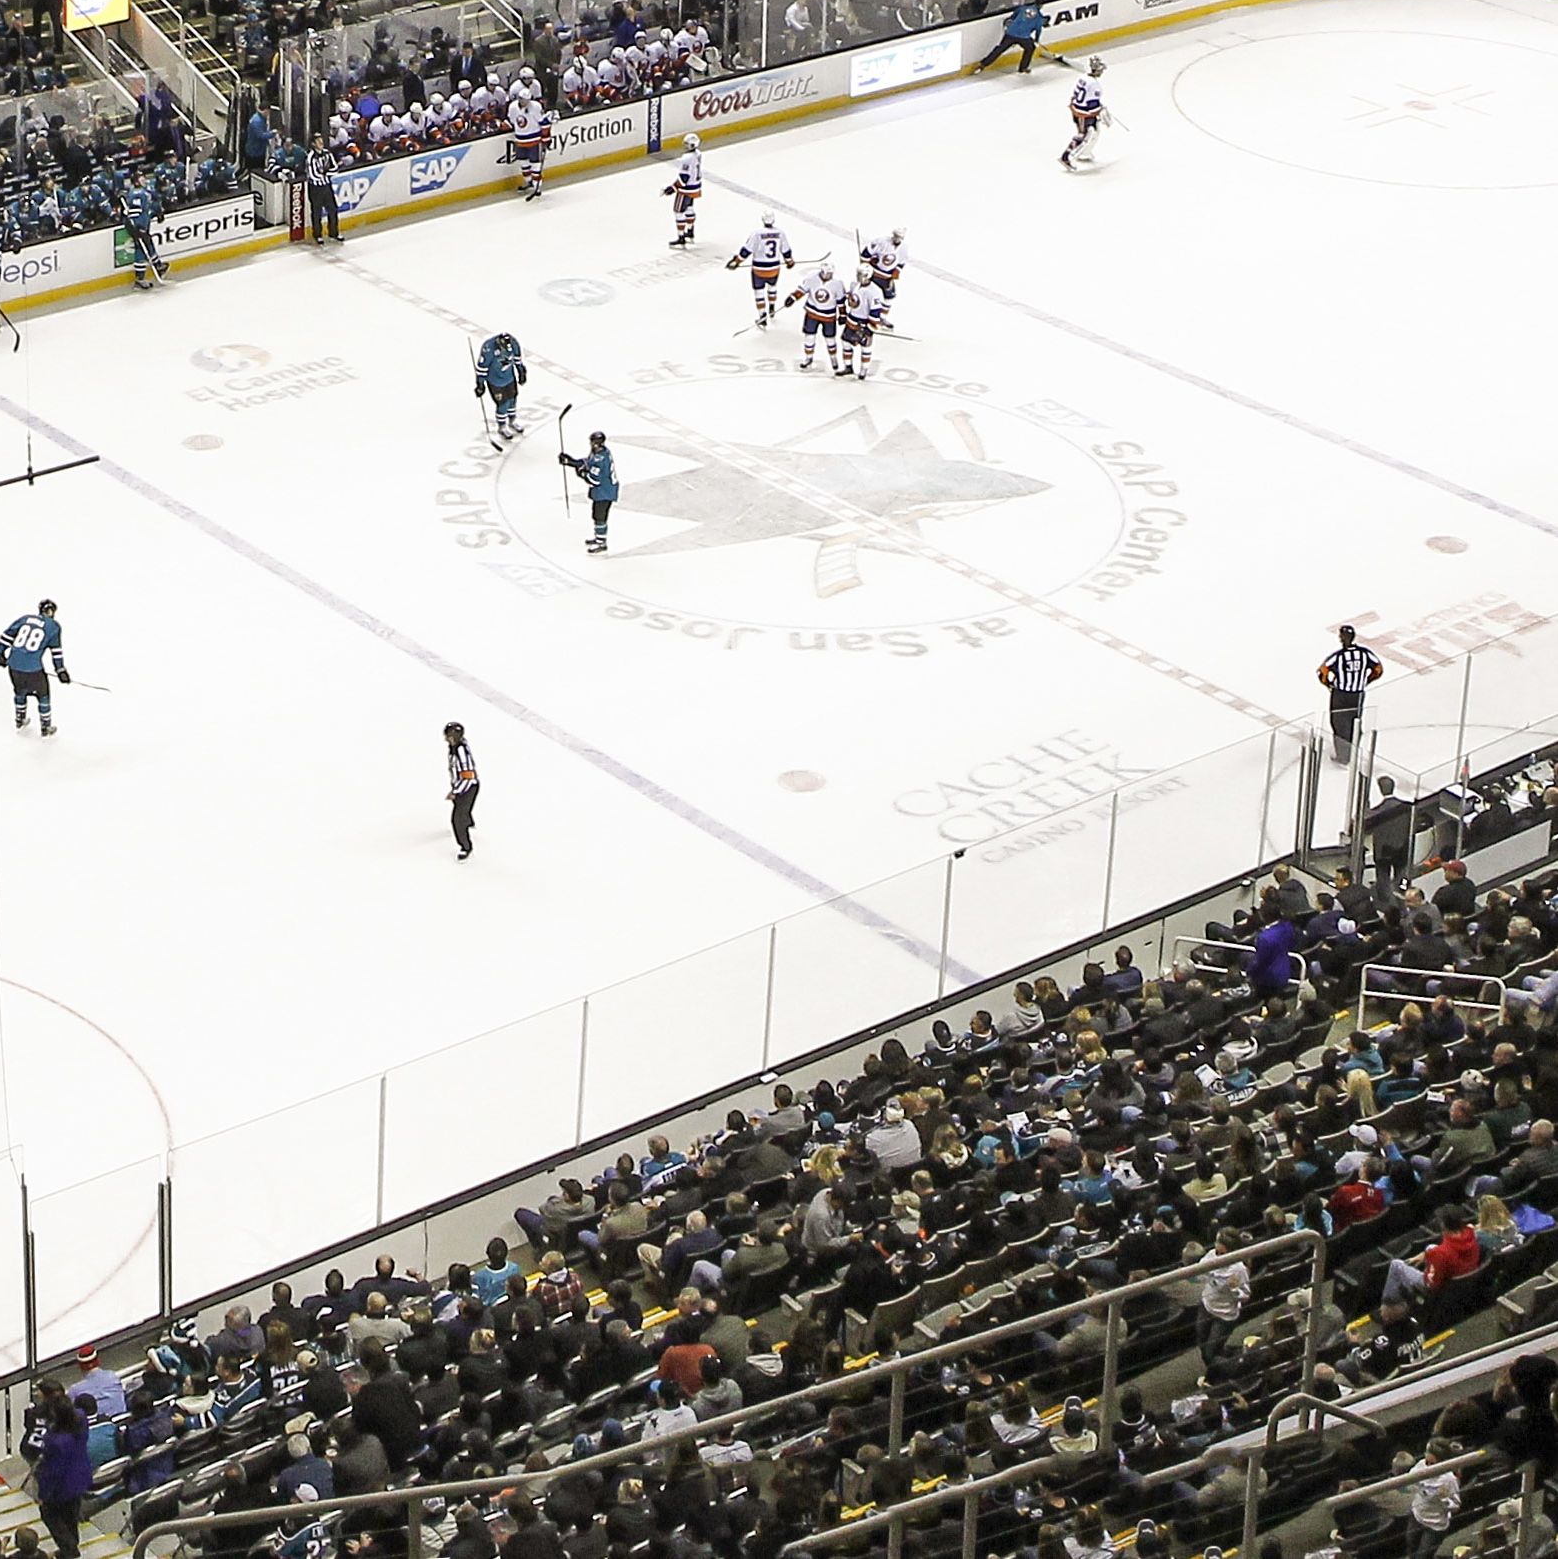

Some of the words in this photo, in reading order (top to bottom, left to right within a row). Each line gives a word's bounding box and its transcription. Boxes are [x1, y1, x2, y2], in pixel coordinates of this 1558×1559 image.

[649, 97, 659, 143] Reebok
[693, 89, 753, 121] Coors
[753, 74, 815, 107] LIGHT
[548, 117, 632, 155] ayStation
[411, 155, 457, 189] SAP
[292, 183, 303, 230] Reebok
[4, 249, 59, 284] epsi
[764, 239, 777, 259] 3
[185, 385, 225, 402] El
[224, 355, 346, 391] Camino
[218, 366, 361, 412] Hospital
[629, 360, 692, 384] at
[1091, 441, 1180, 497] SAP
[435, 489, 512, 549] SAP
[1077, 507, 1189, 602] Center
[12, 624, 46, 652] 88
[605, 600, 766, 650] Jose
[788, 631, 930, 658] San
[942, 617, 1018, 649] at
[892, 728, 1110, 817] CACHE
[938, 751, 1164, 843] CREEK
[980, 818, 1087, 864] CASINO
